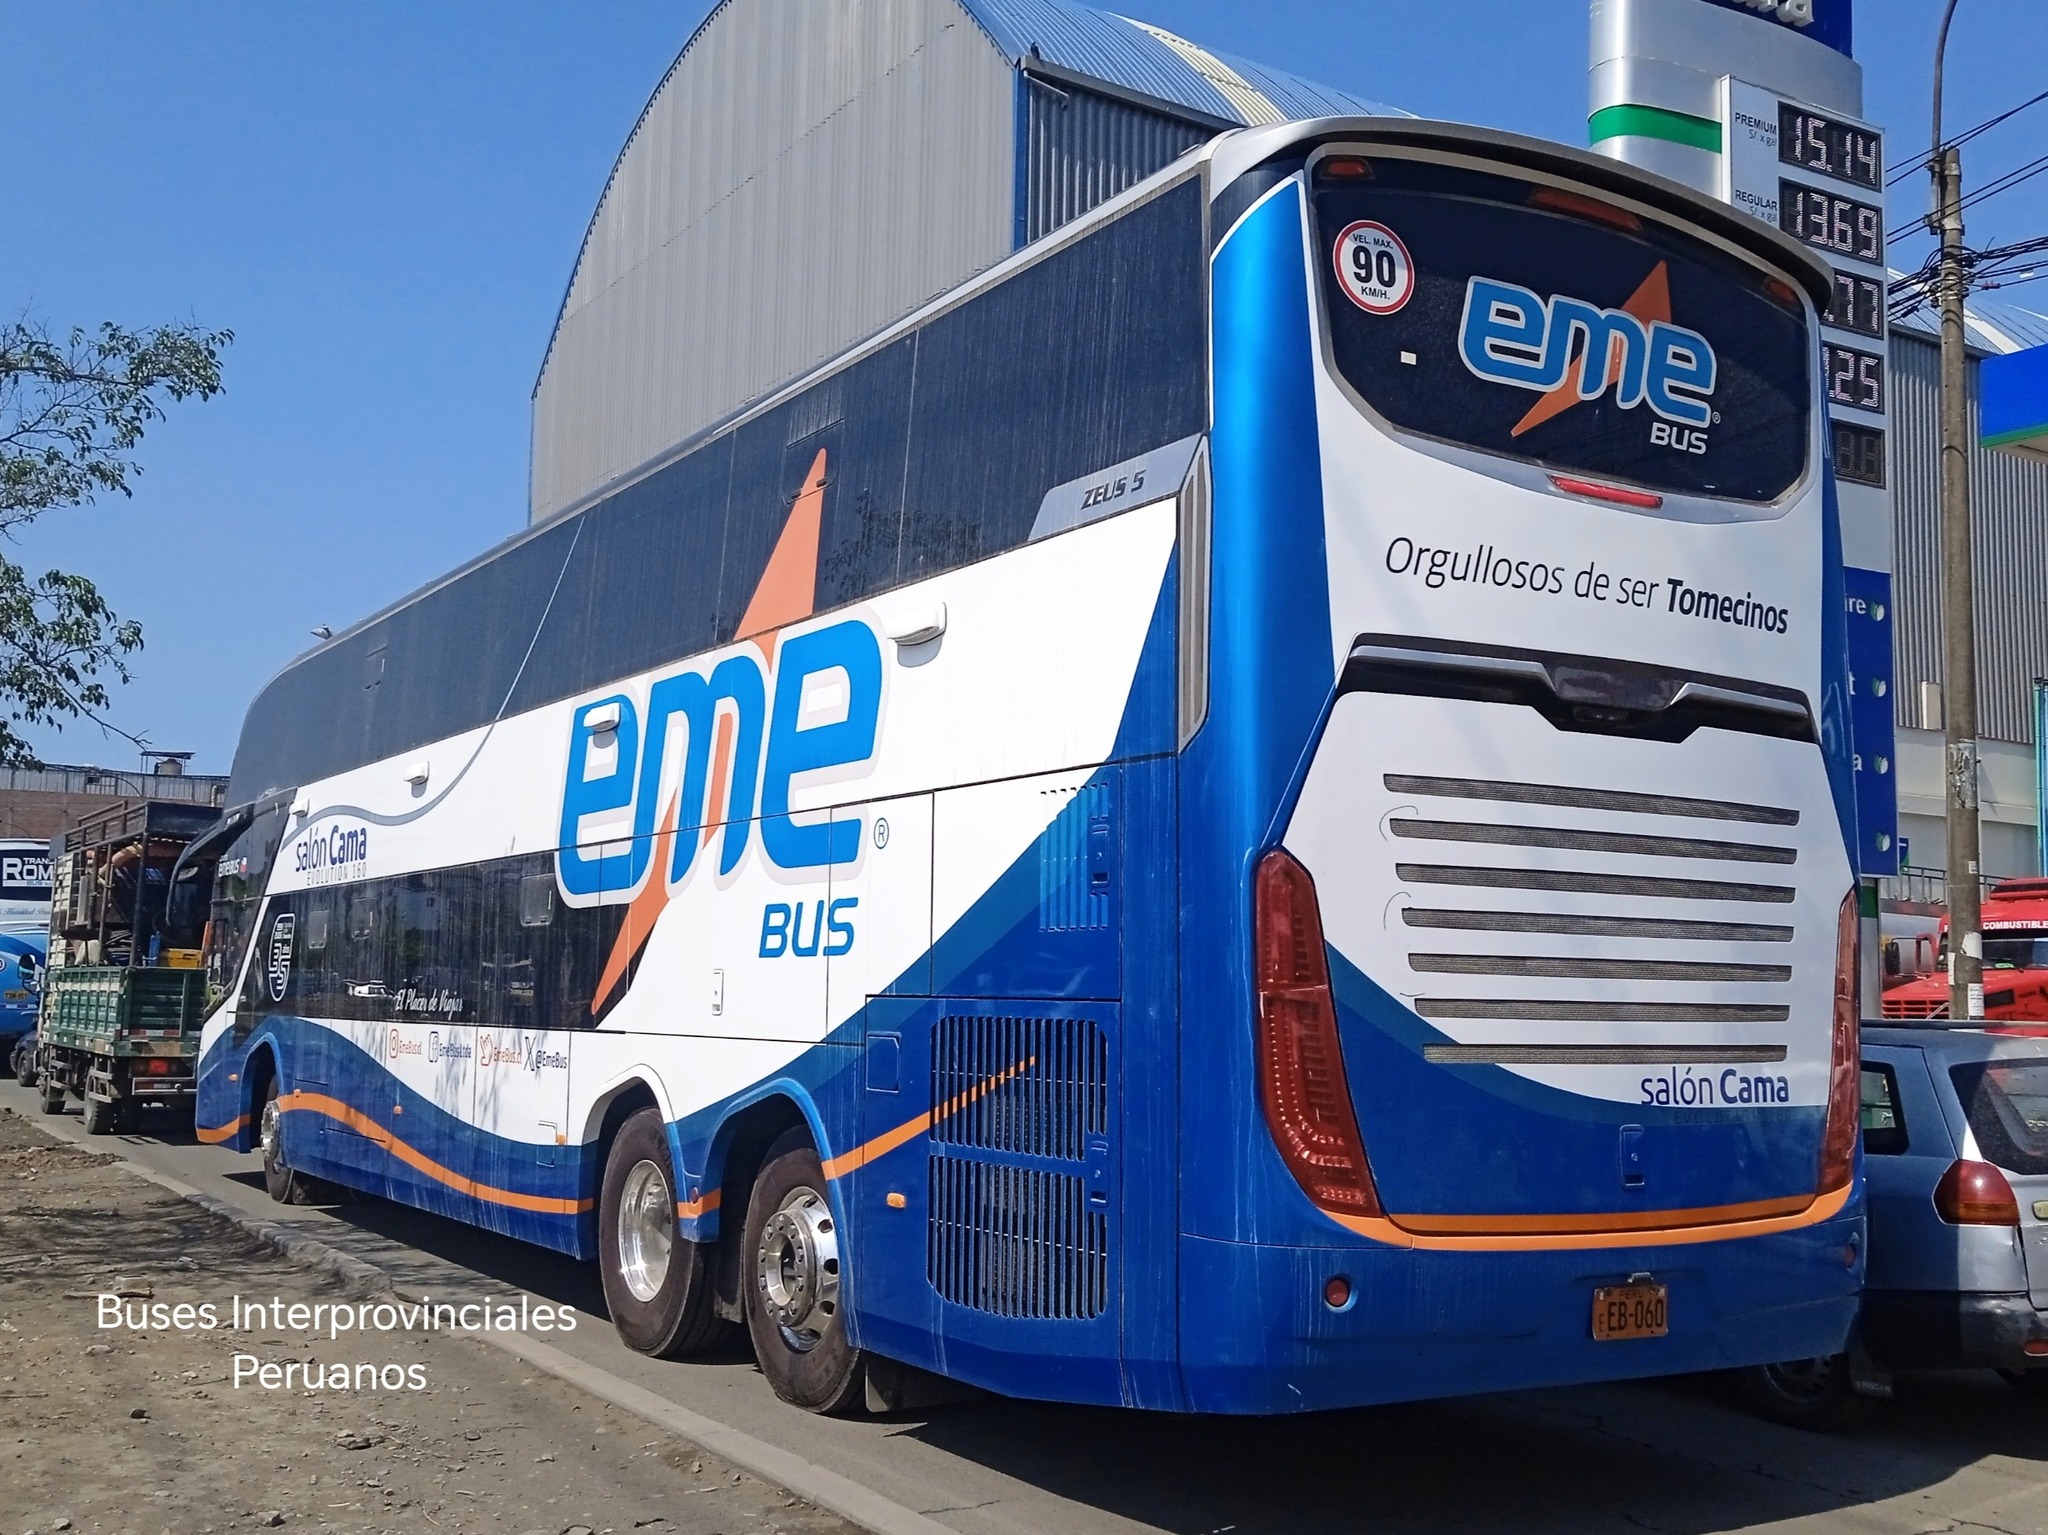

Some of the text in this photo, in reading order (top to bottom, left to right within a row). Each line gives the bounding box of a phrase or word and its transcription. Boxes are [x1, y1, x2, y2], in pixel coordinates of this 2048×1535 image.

[1734, 112, 1777, 136] PREMIUM
[1794, 115, 1876, 185] 15.14
[1735, 189, 1778, 212] REGULAR
[1352, 233, 1394, 250] VEL. MAX.
[1795, 191, 1878, 259] 13.69
[1352, 245, 1396, 288] 90
[1361, 285, 1390, 300] KM/H.
[1458, 276, 1717, 428] eme
[1650, 421, 1708, 455] BUS
[1080, 469, 1146, 511] ZEUS 5
[1386, 536, 1789, 635] Orgullosos de ser Tomecinos
[556, 610, 886, 905] eme
[296, 824, 367, 873] salón Cama
[306, 861, 367, 886] EVOLUTION 160
[758, 896, 859, 958] BUS
[1982, 920, 2048, 930] COMBUSTIBLE
[395, 988, 406, 1011] El
[428, 988, 438, 1012] de
[535, 1049, 567, 1069] @EmeBus
[1640, 1065, 1790, 1106] salón Cama
[1608, 1298, 1664, 1331] EB-060
